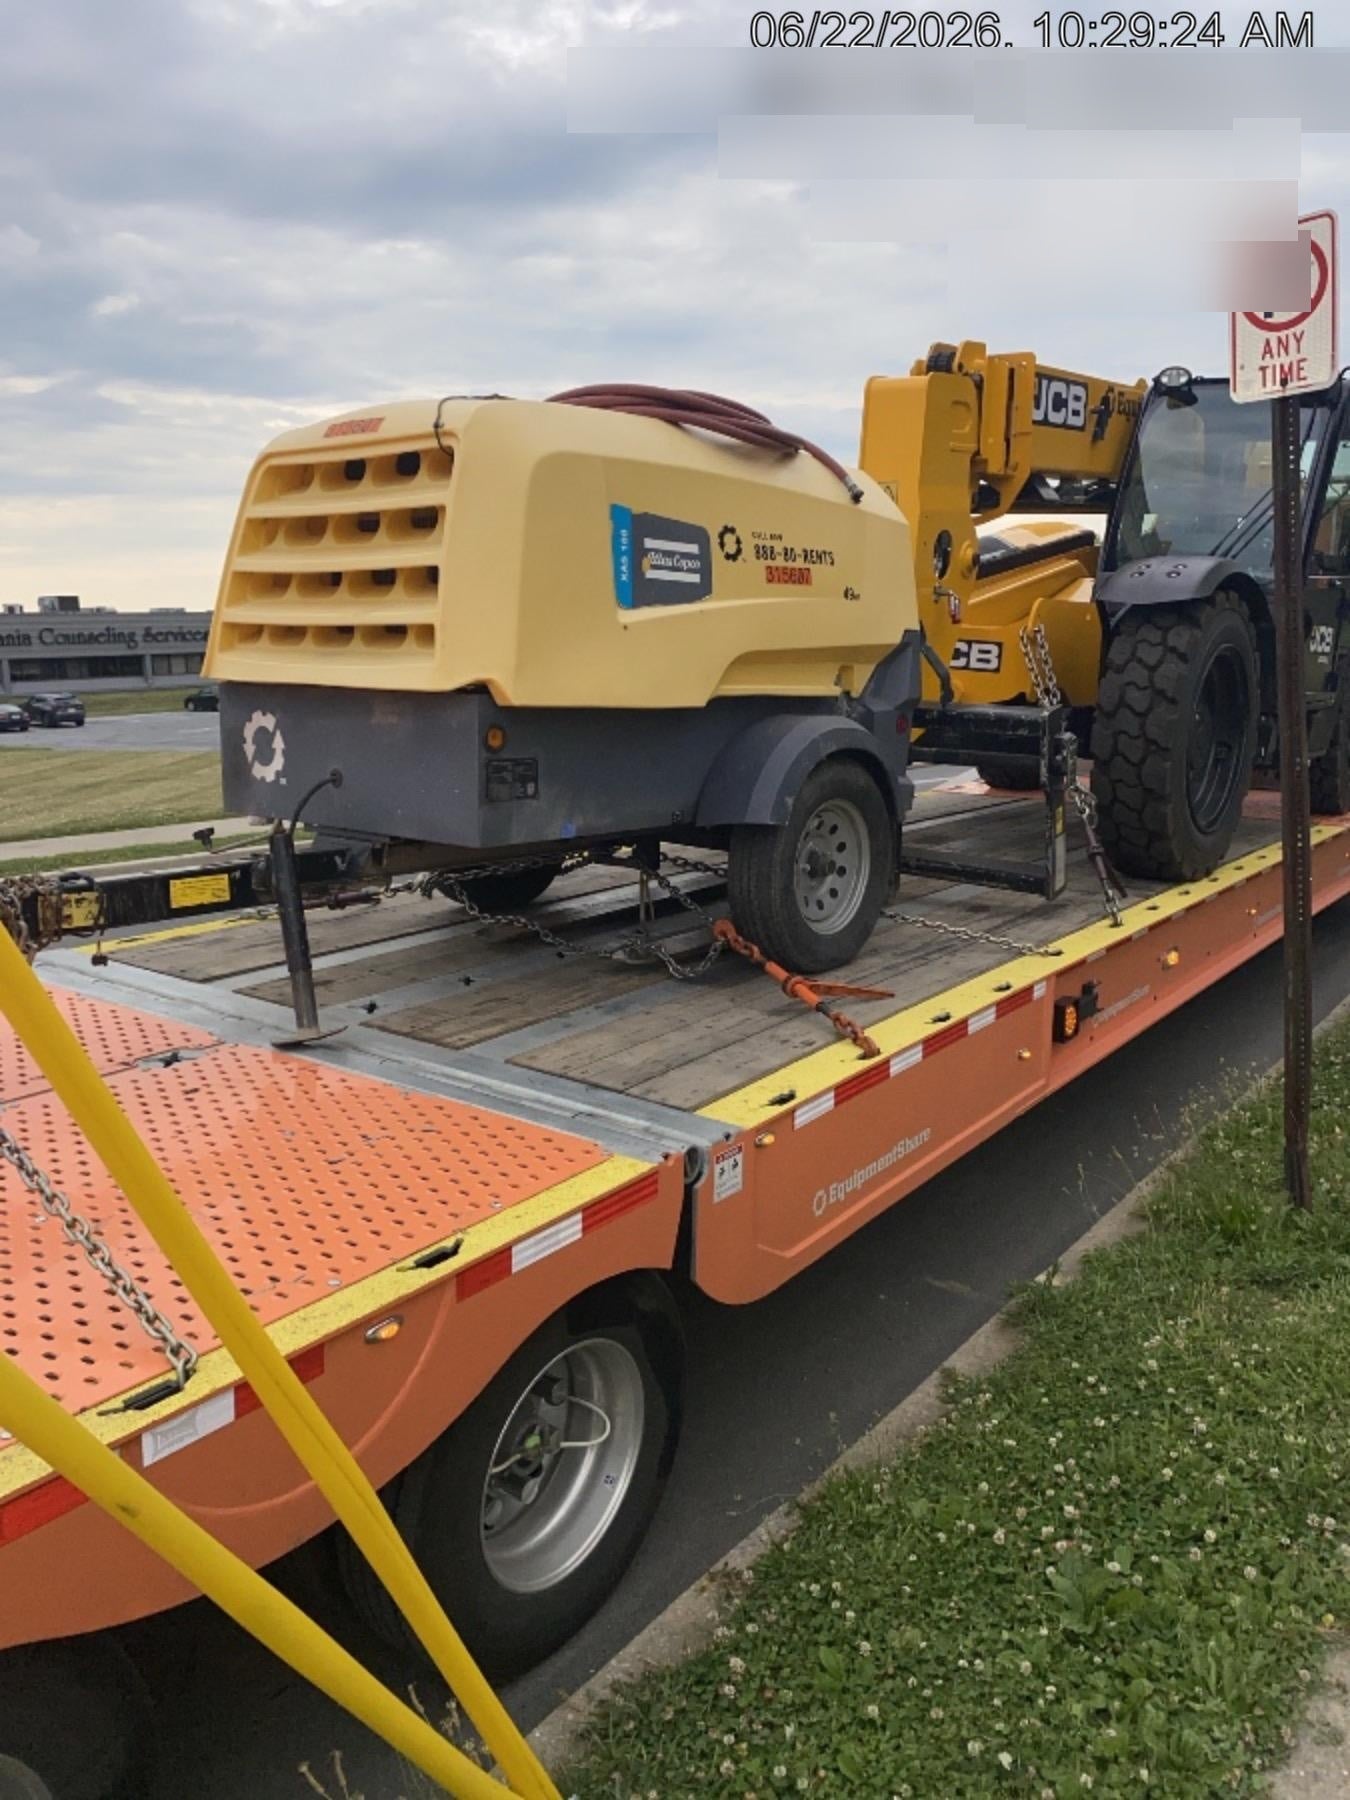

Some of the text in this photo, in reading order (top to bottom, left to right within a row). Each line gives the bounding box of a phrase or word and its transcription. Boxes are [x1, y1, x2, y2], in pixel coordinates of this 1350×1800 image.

[1261, 330, 1305, 361] ANY
[1258, 357, 1309, 388] TIME
[1032, 378, 1085, 427] JCB
[673, 554, 701, 570] Copco
[753, 543, 835, 567] 888-80-RENTS
[39, 627, 138, 650] Counseling
[829, 1127, 932, 1205] EquipmentShare
